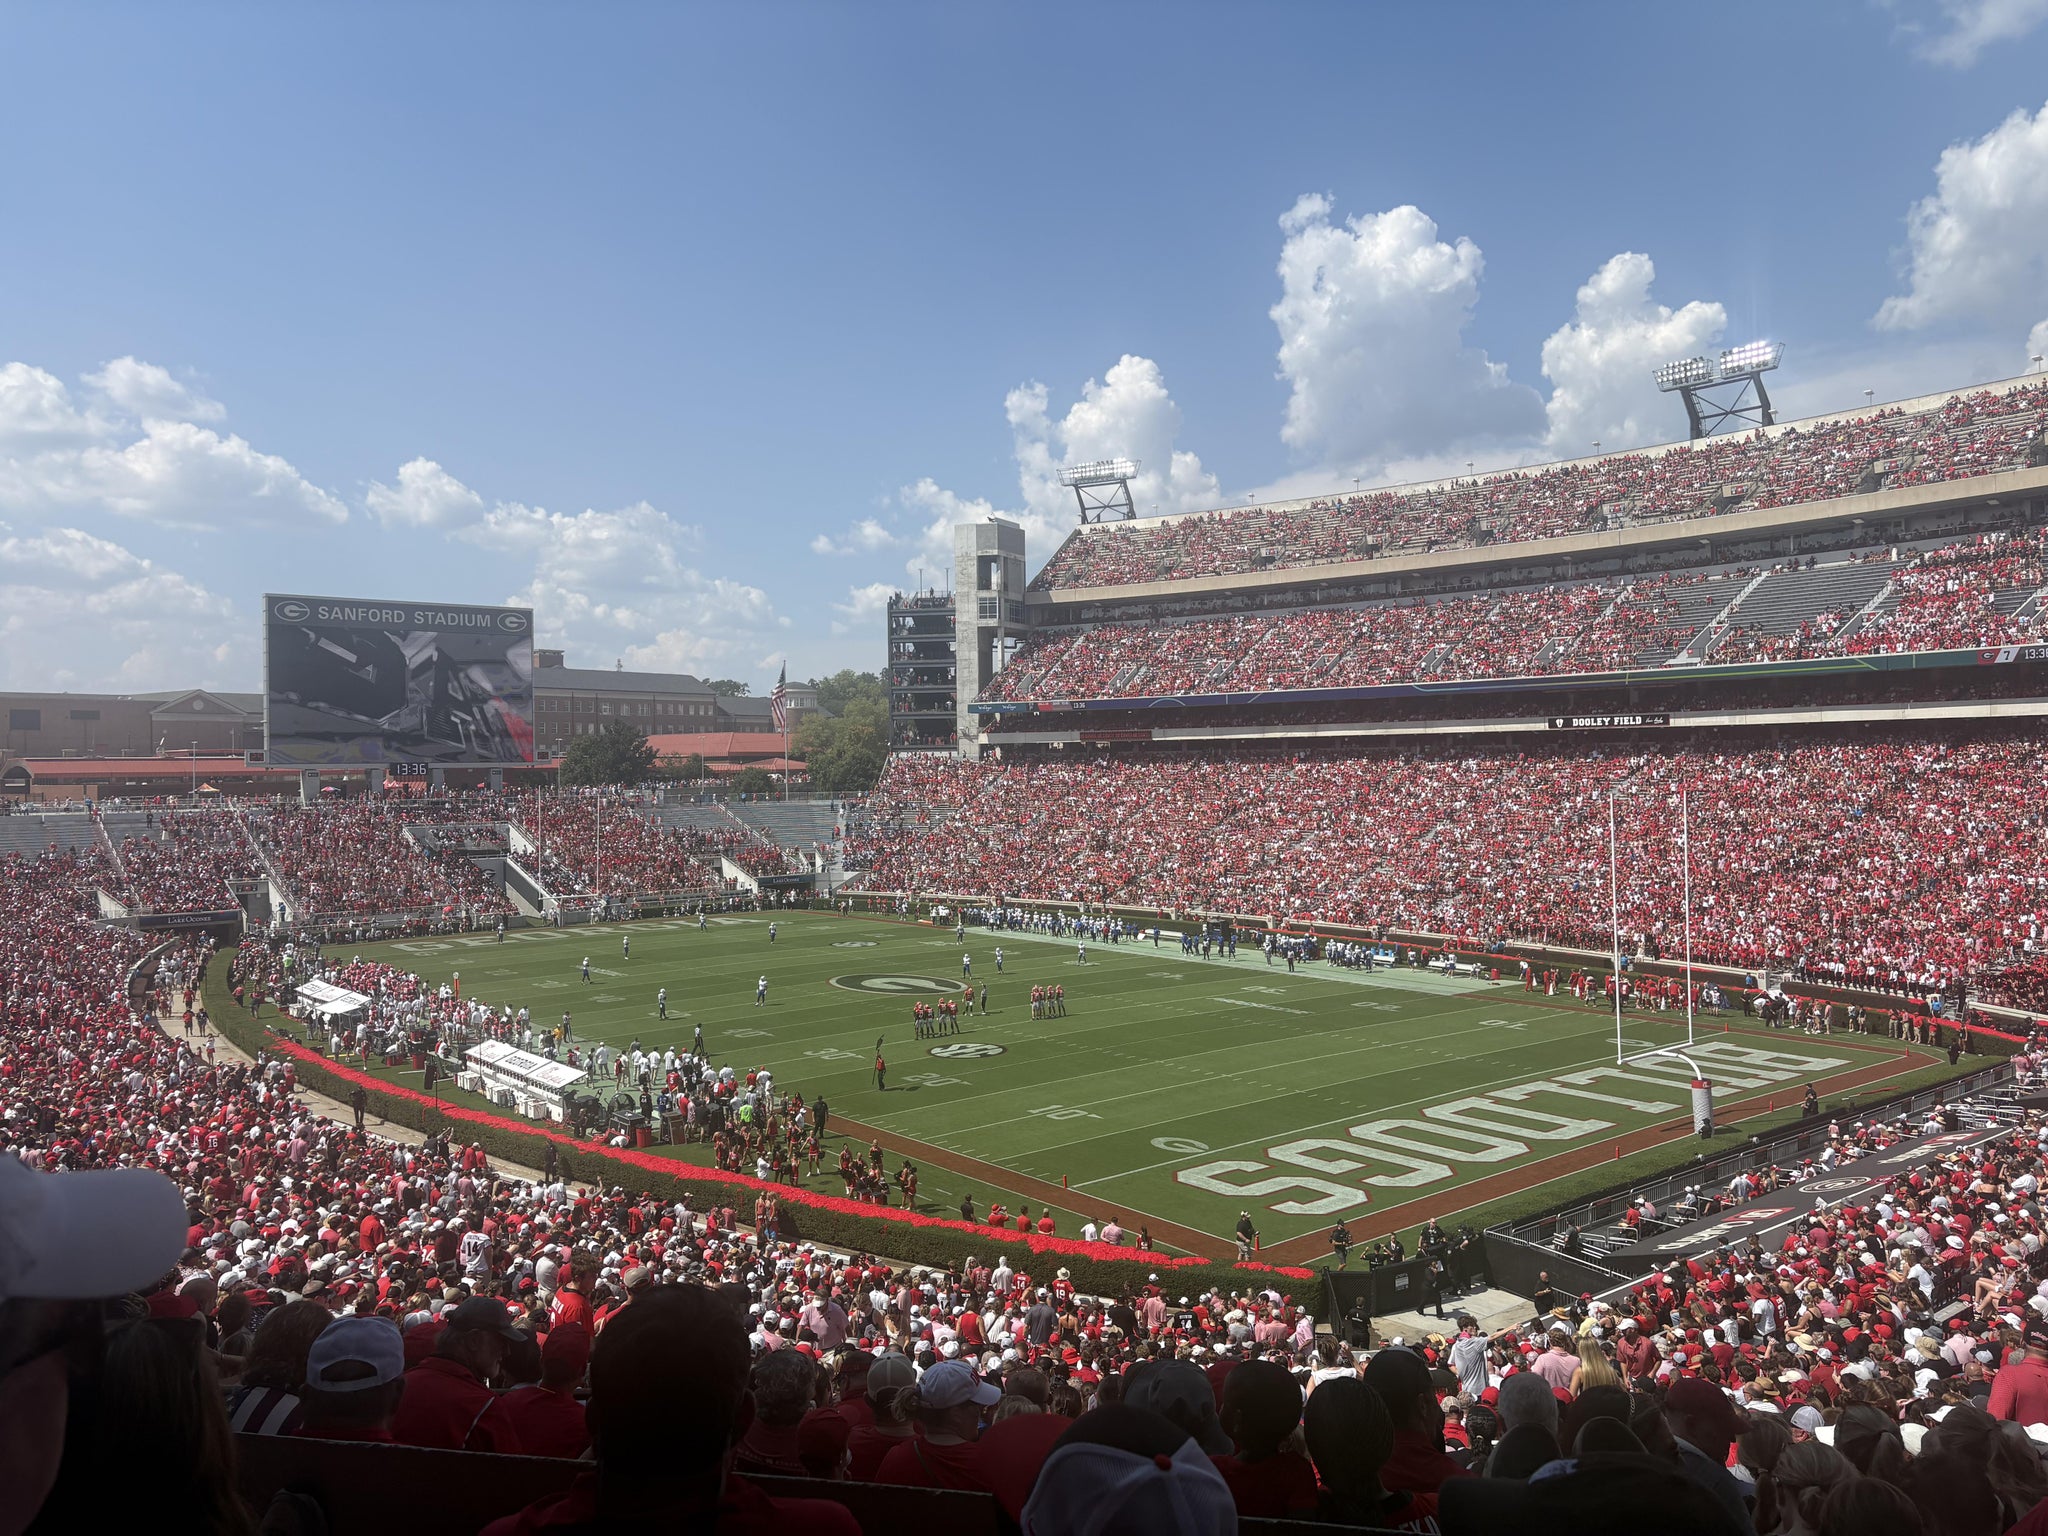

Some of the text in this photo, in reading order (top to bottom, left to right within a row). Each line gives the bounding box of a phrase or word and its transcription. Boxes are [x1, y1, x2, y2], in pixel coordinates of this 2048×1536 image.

[318, 606, 405, 623] SANFORD
[414, 611, 491, 627] STADIUM
[2003, 650, 2010, 661] 7
[1572, 717, 1610, 727] DOOLEY
[1613, 716, 1642, 725] FIELD
[397, 763, 427, 775] 13:36
[390, 916, 770, 952] GEORGIA
[900, 1072, 962, 1087] 20
[1026, 1104, 1089, 1120] 10
[1176, 1041, 1852, 1215] BULLDOGS
[208, 1138, 218, 1148] 16
[1151, 1137, 1209, 1154] G
[467, 1241, 480, 1256] 14
